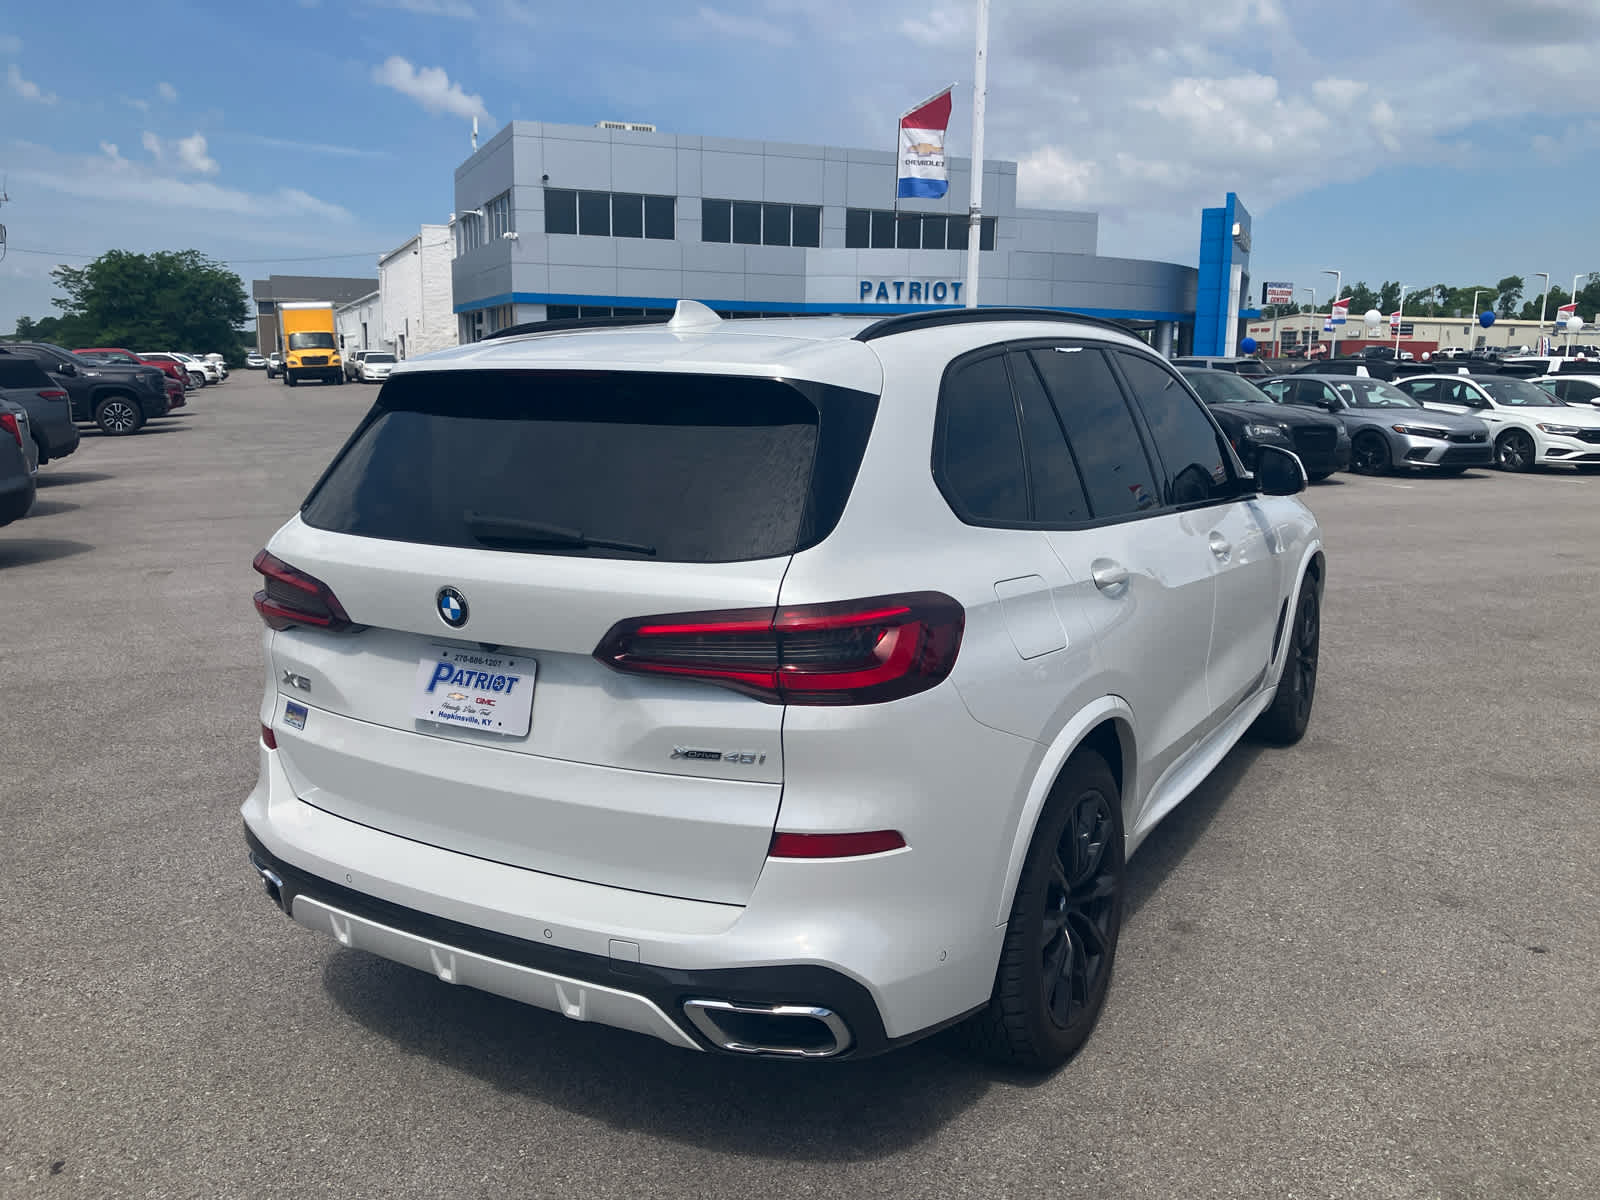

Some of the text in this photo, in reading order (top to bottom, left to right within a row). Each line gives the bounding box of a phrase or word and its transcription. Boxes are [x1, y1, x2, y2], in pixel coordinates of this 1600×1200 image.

[859, 280, 963, 301] PATRIOT
[427, 661, 520, 694] PATRIOT
[475, 697, 497, 706] GMC
[438, 710, 493, 726] Hopkinsville, KY
